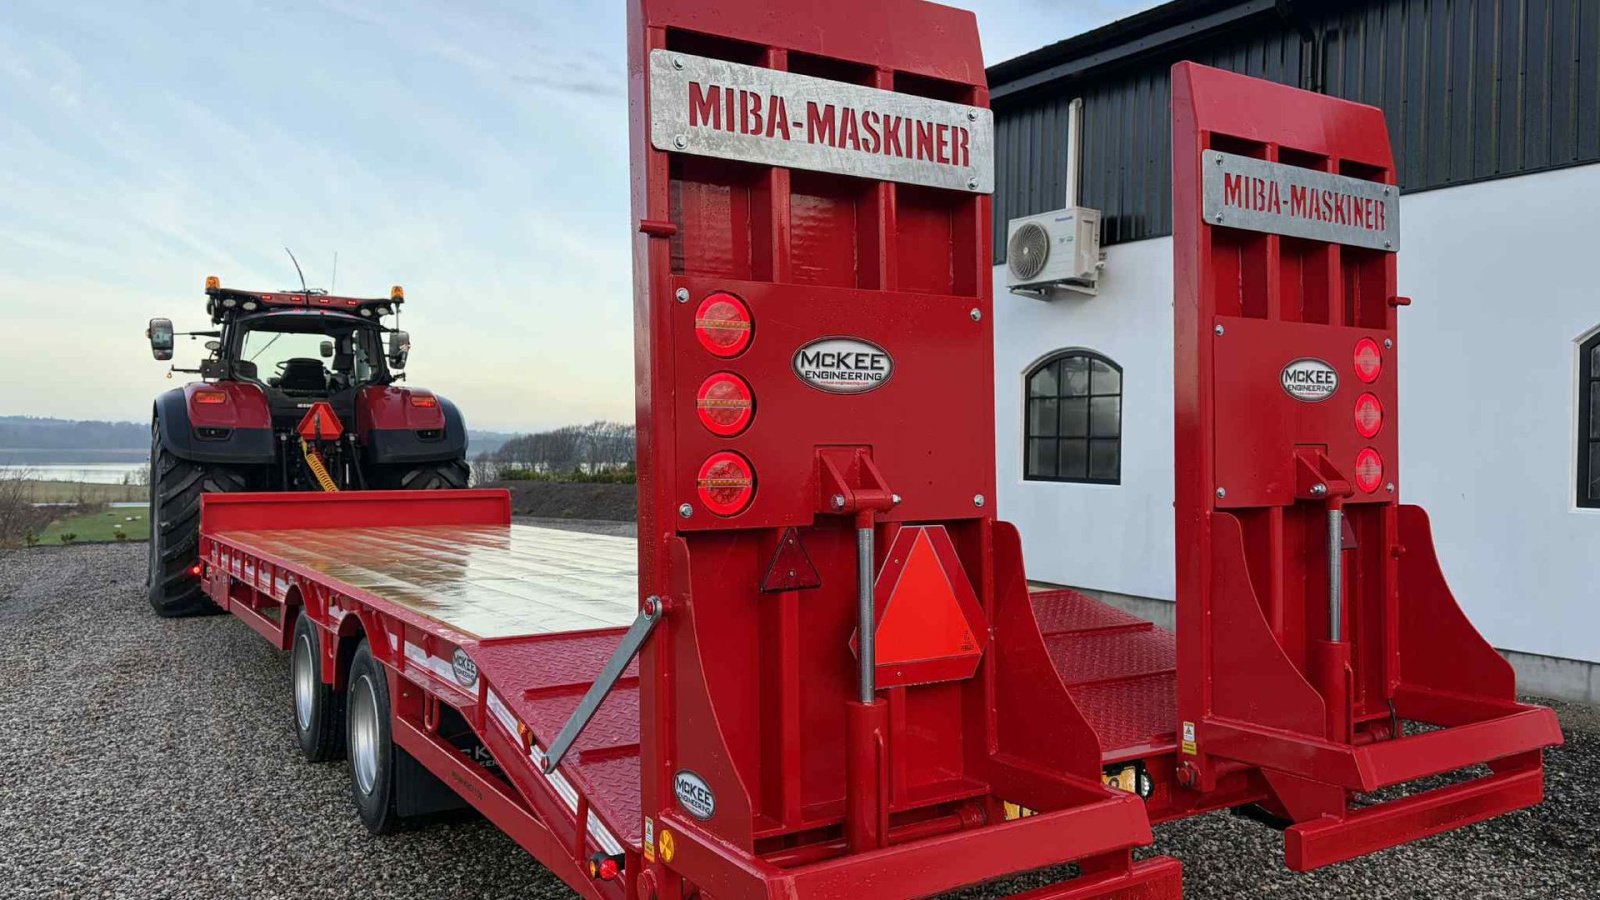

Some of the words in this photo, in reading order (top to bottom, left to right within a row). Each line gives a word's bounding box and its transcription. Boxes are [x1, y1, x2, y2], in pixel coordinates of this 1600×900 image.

[689, 81, 969, 167] MIBA-MASKINER
[1224, 172, 1385, 231] MIBA-MASKINER
[805, 371, 882, 381] ENGINEERING
[1287, 384, 1333, 392] ENGINEERING
